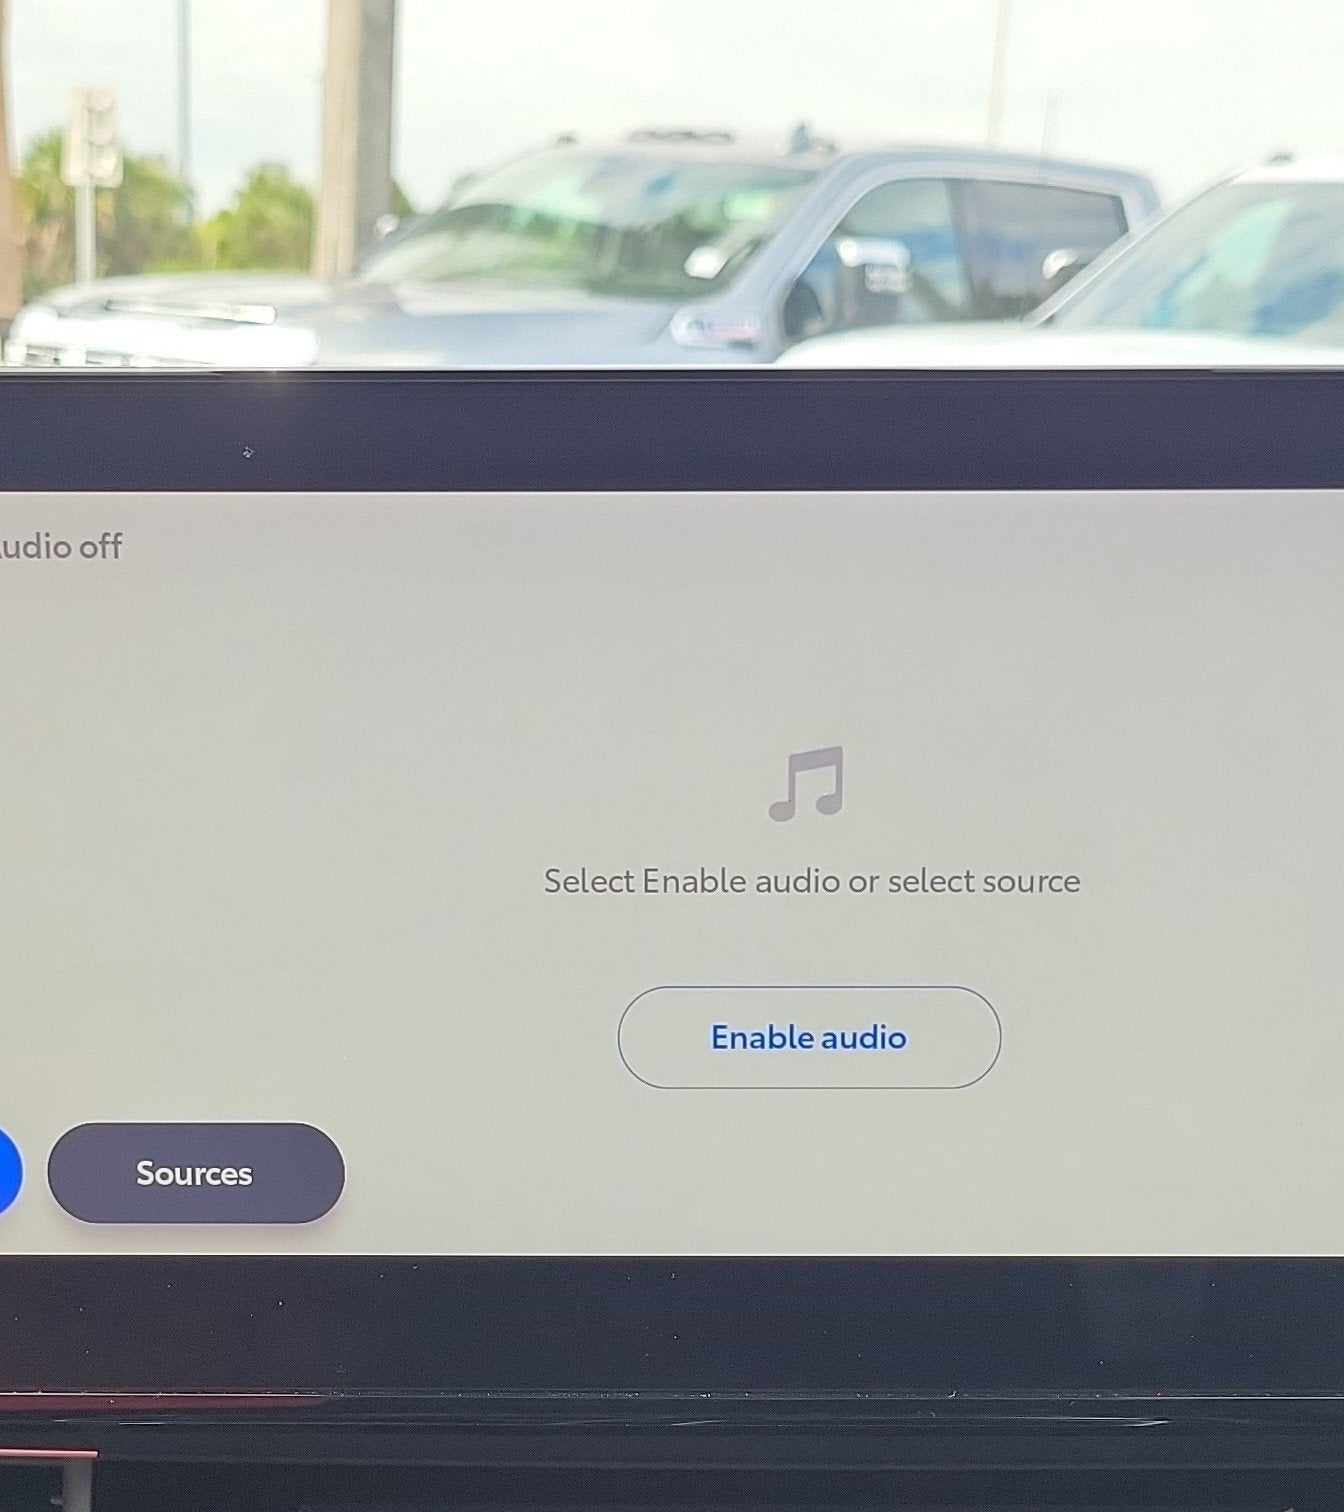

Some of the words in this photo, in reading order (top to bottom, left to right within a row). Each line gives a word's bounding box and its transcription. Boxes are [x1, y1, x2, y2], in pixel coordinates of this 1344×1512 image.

[79, 532, 122, 560] off
[544, 868, 634, 894] Select
[643, 867, 746, 894] Enable
[756, 867, 840, 894] audio
[848, 875, 879, 894] or
[888, 868, 974, 894] select
[983, 875, 1081, 894] source
[711, 1024, 815, 1050] Enable
[822, 1024, 907, 1050] audio
[136, 1160, 253, 1187] Sources
